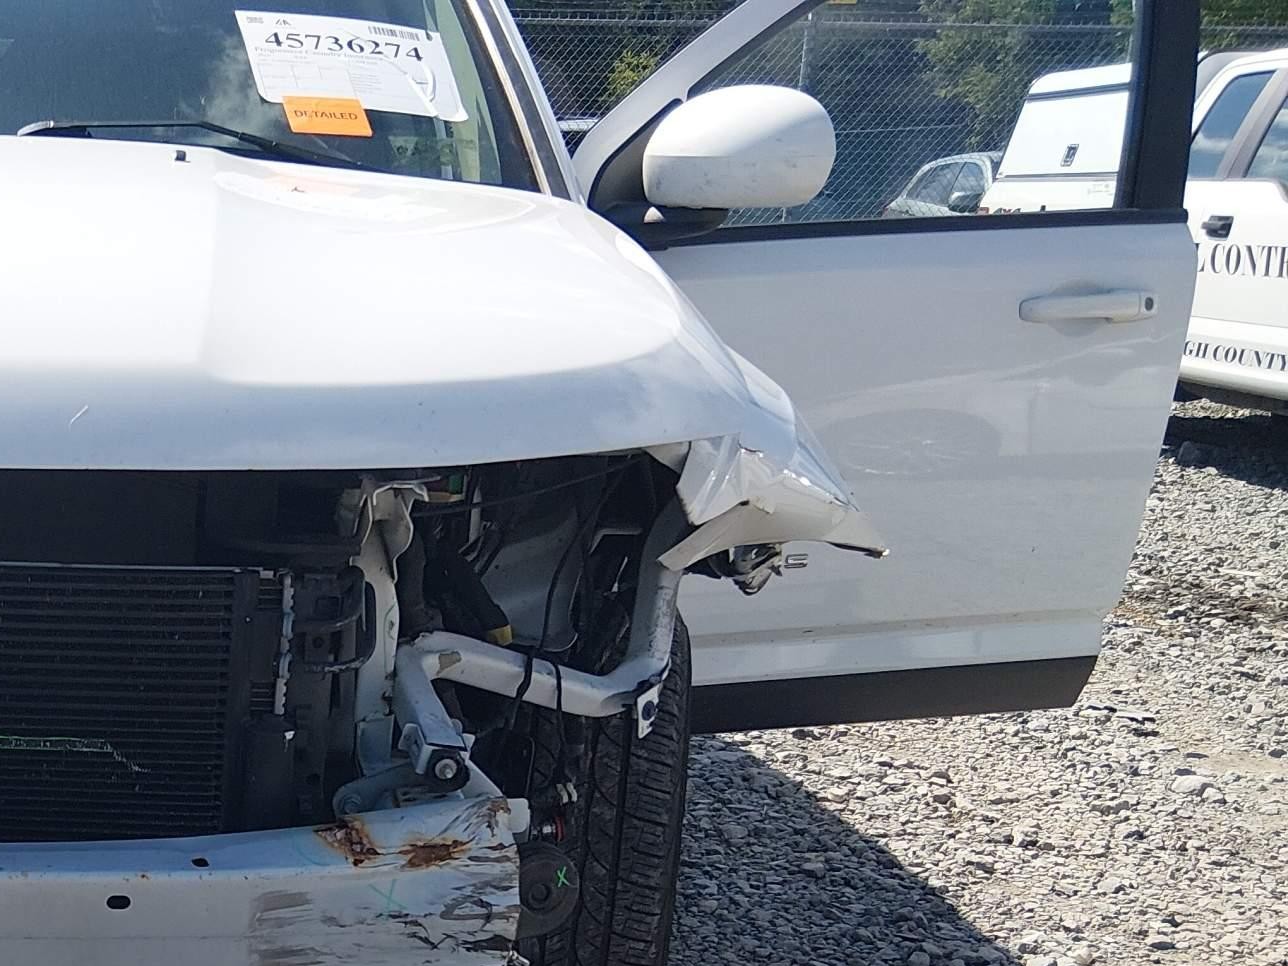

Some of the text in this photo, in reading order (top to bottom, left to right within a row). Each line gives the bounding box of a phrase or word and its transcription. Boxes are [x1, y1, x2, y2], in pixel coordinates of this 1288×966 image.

[264, 31, 424, 62] 45736274
[293, 109, 359, 121] DETAILED
[1212, 344, 1288, 372] COUNTY
